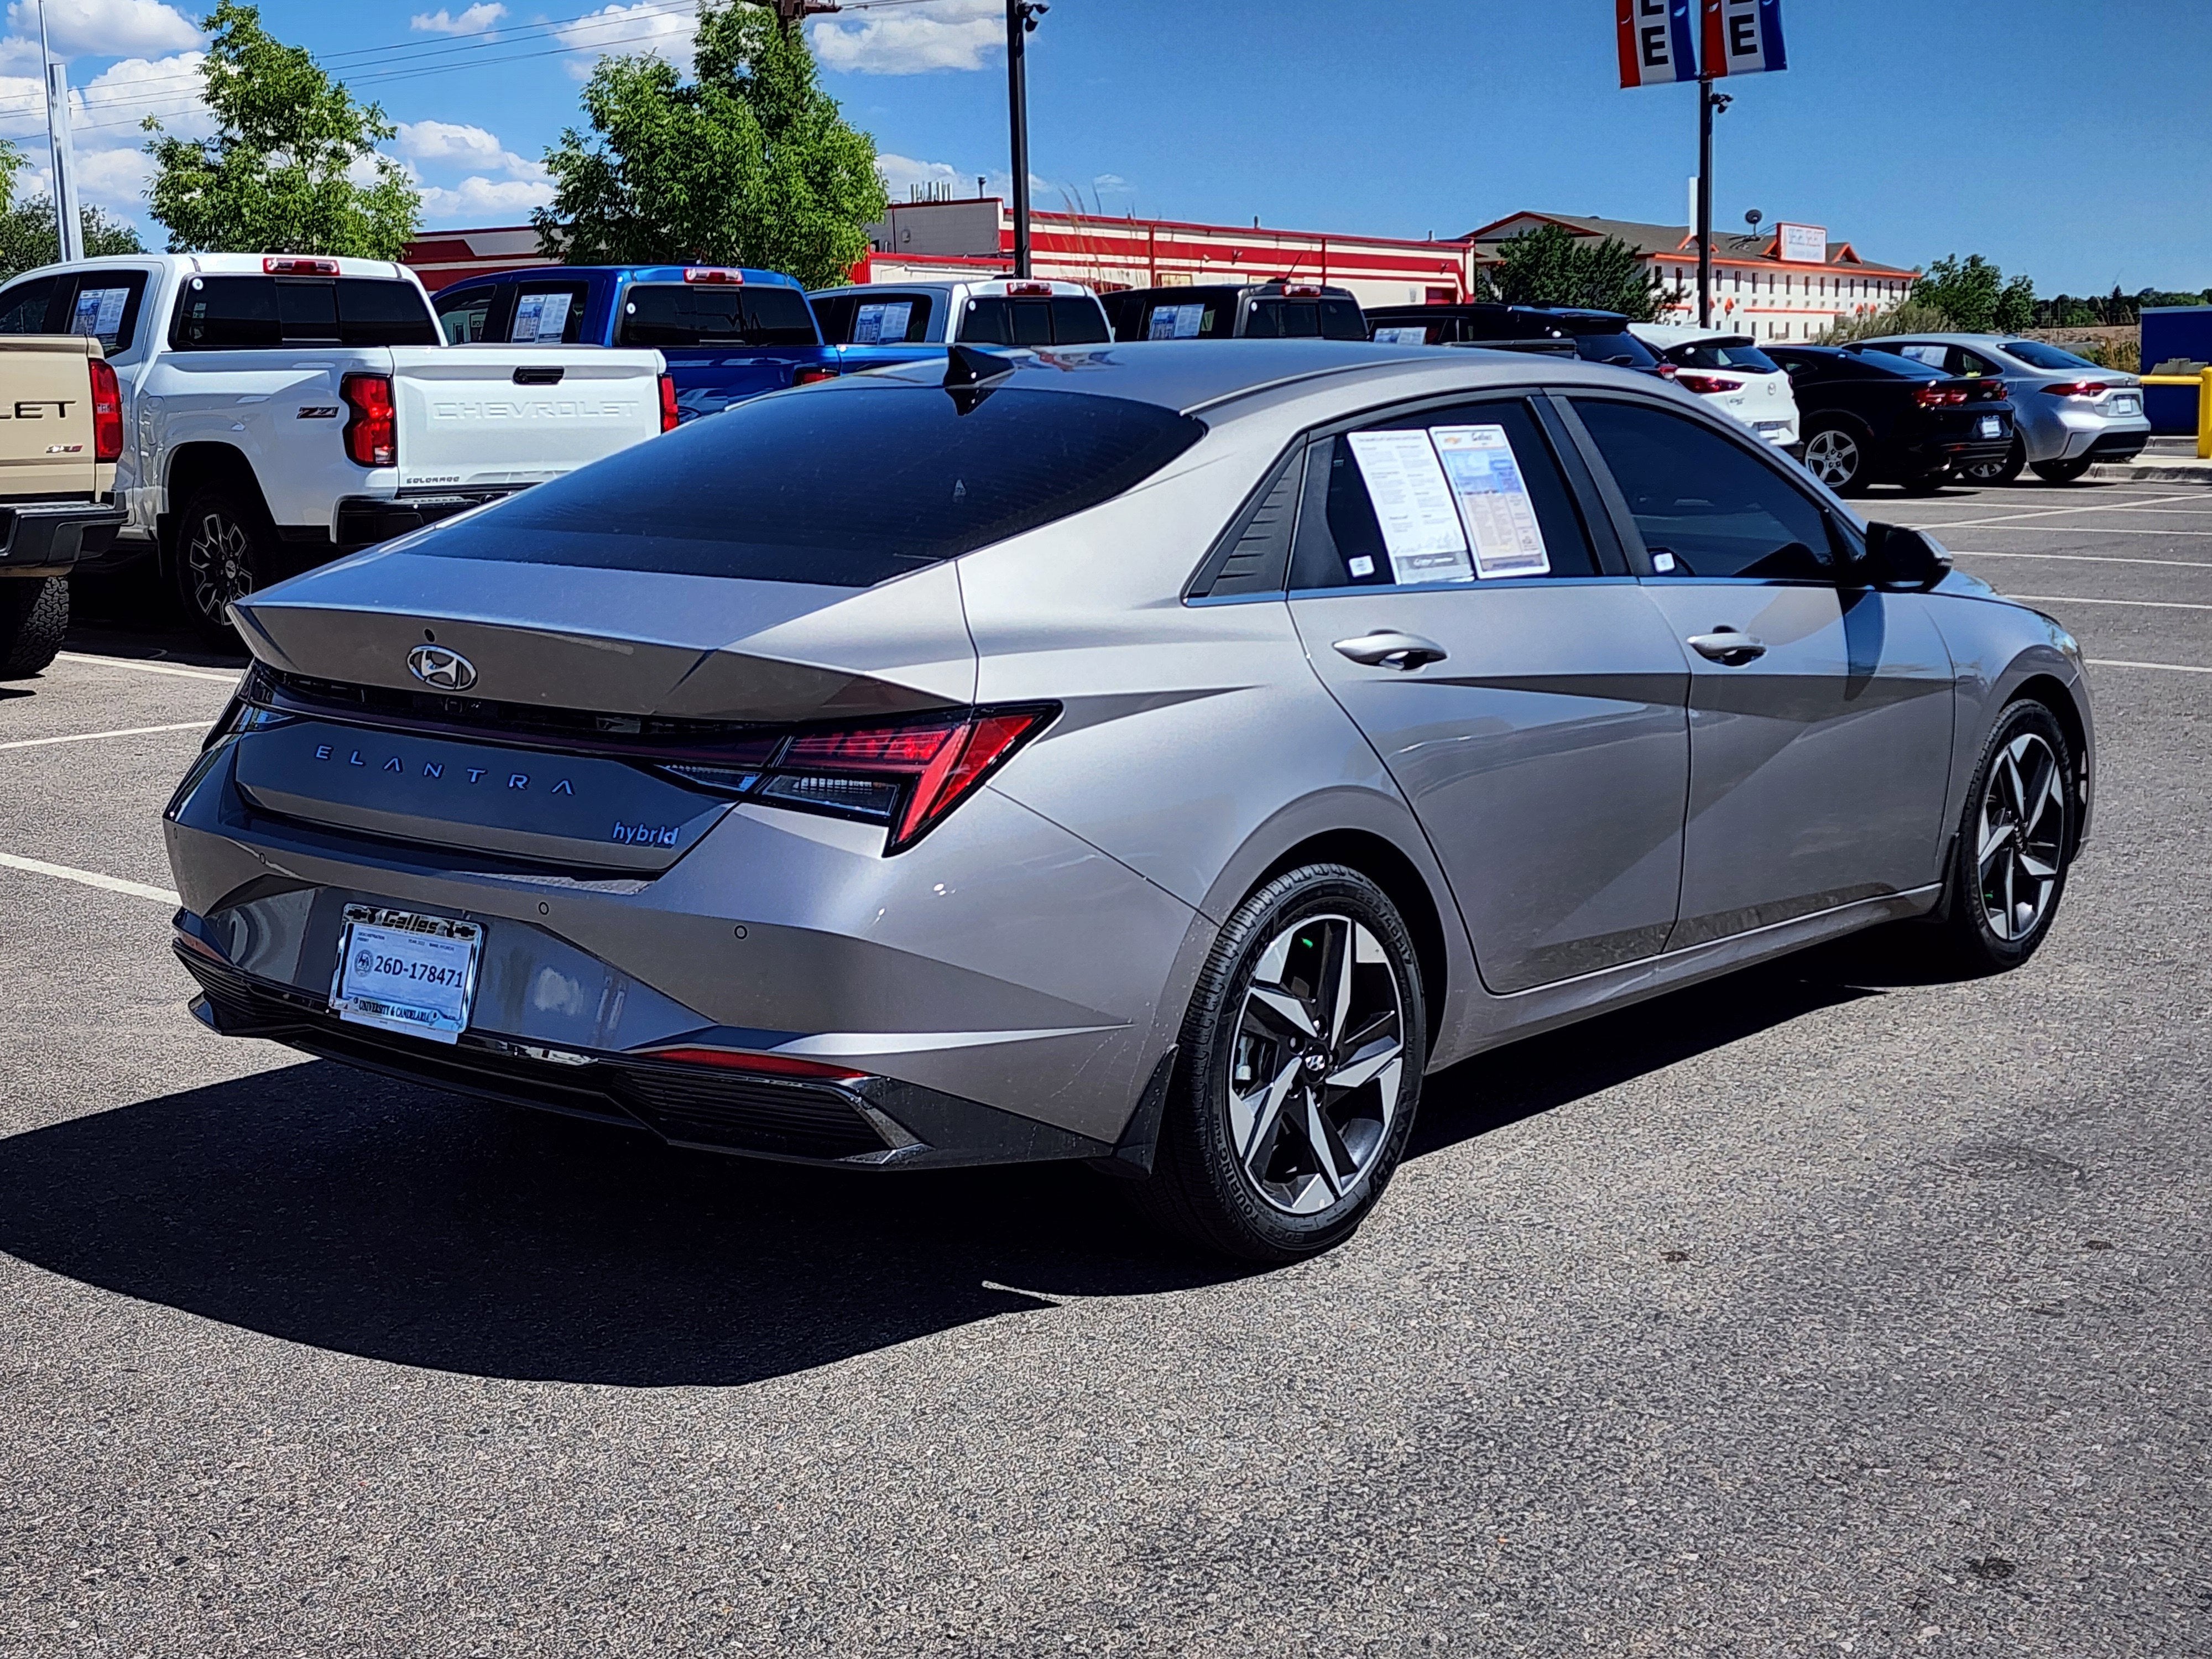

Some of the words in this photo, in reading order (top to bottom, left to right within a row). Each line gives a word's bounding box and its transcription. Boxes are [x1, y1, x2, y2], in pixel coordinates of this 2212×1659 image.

[433, 401, 639, 419] CHEVROLET
[316, 744, 575, 795] ELANTRA
[613, 821, 679, 847] hybrid
[374, 955, 463, 988] 26D-178471
[359, 1000, 389, 1016] UNIVERSITY
[396, 1008, 430, 1021] CANDELARIA
[1217, 1145, 1261, 1225] TOURING
